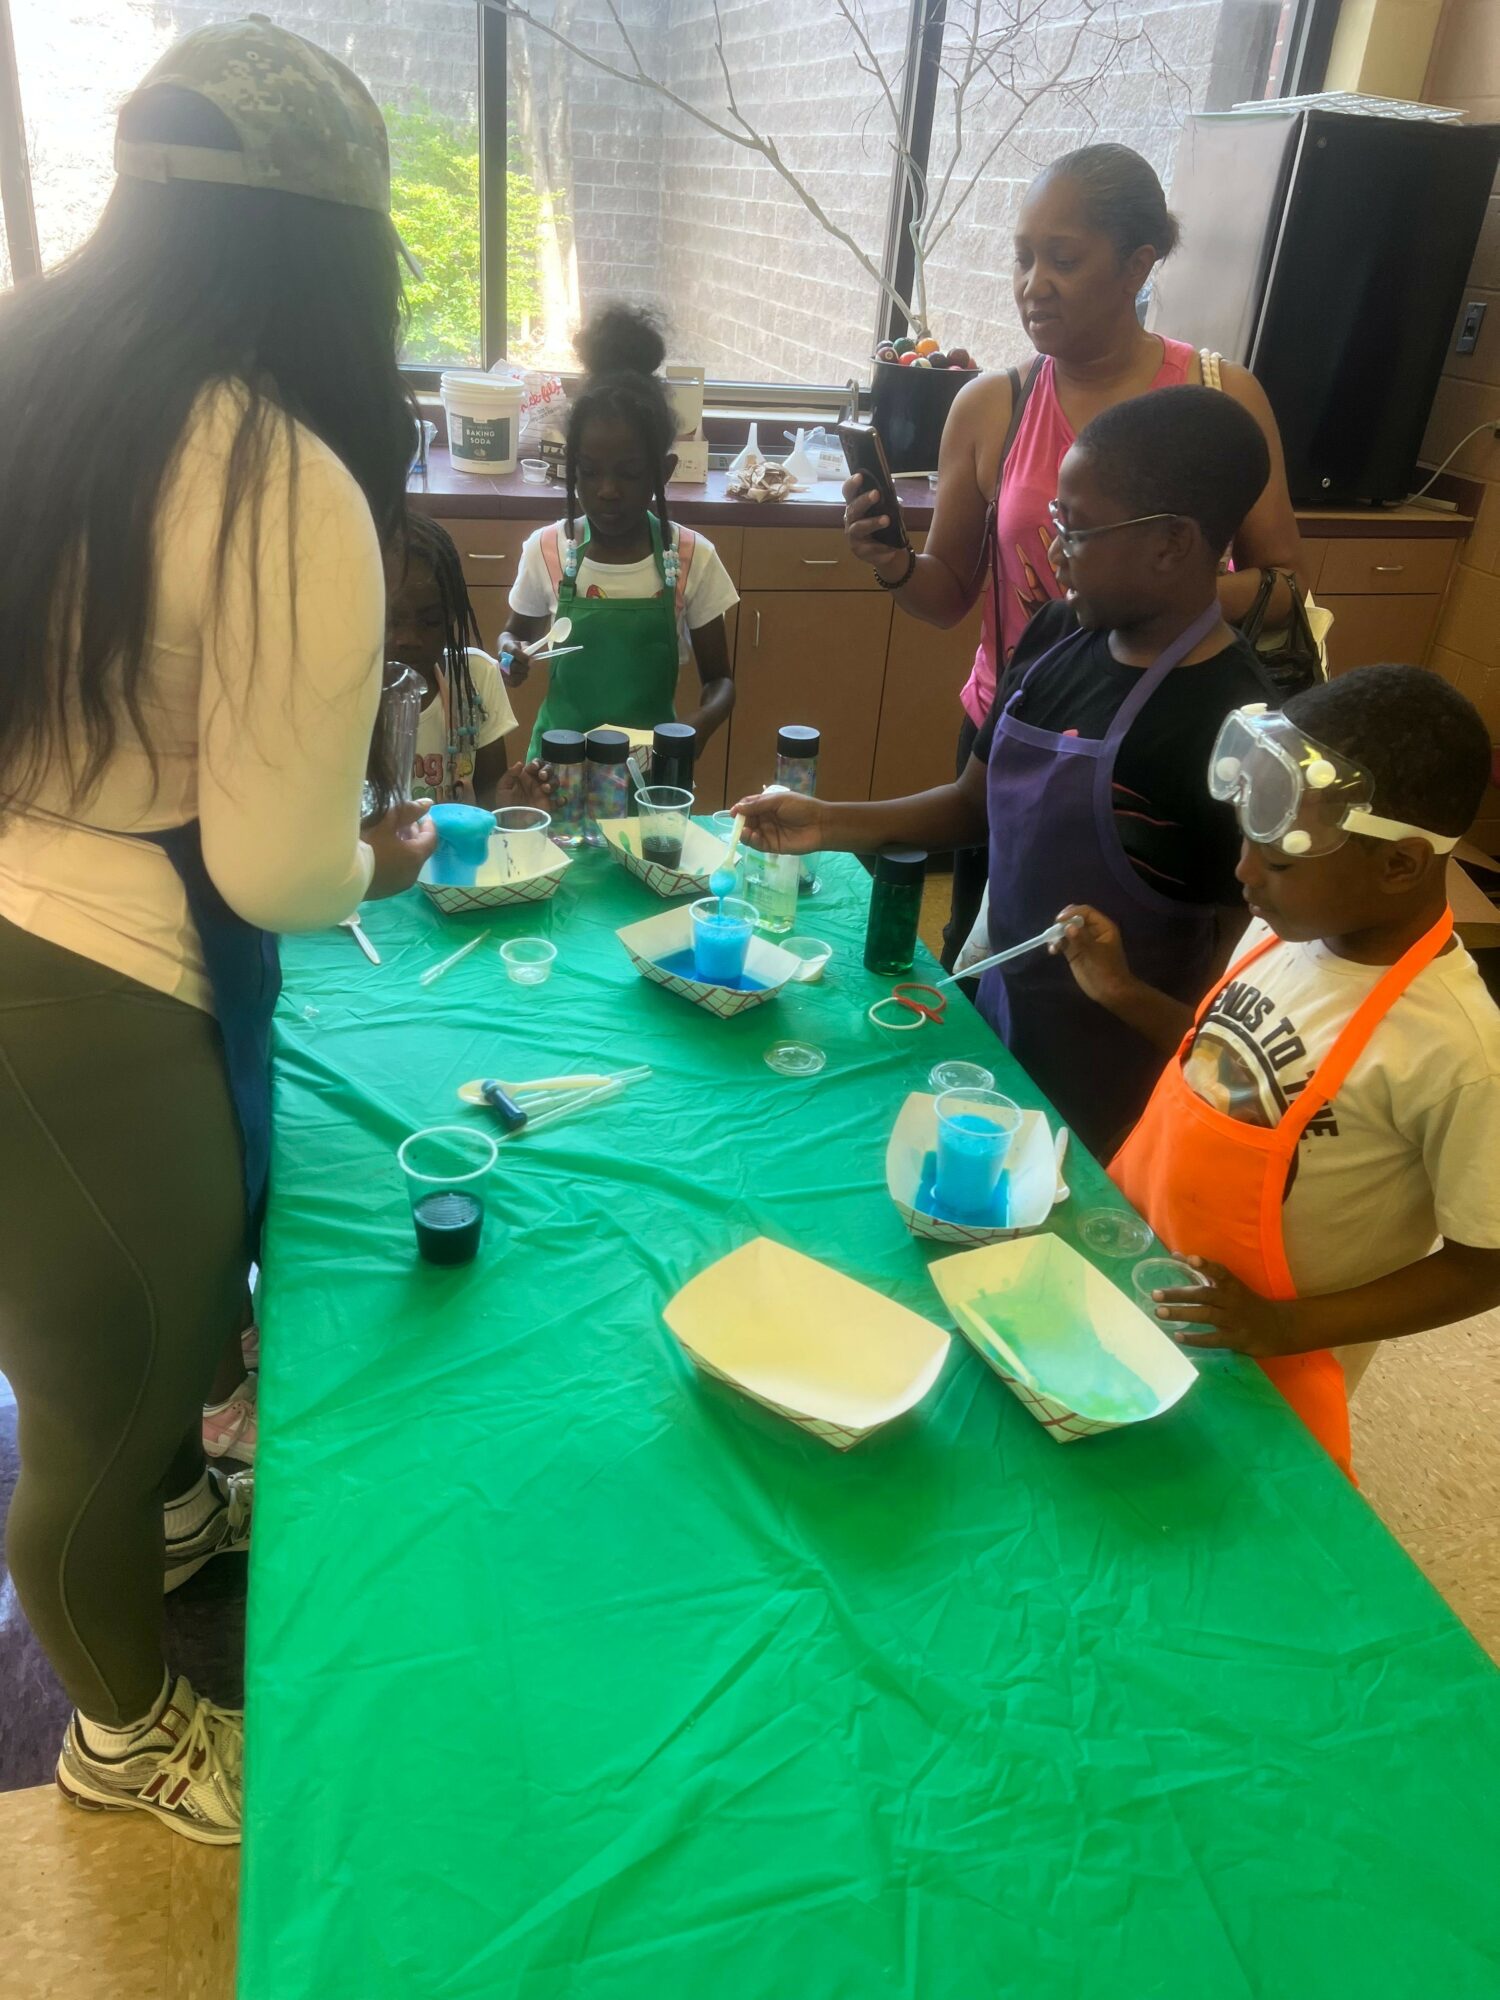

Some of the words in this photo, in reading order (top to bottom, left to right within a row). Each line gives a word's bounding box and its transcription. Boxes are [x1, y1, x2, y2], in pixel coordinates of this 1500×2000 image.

[466, 428, 495, 437] BAKING
[470, 437, 491, 445] SODA
[1260, 1016, 1307, 1072] TO
